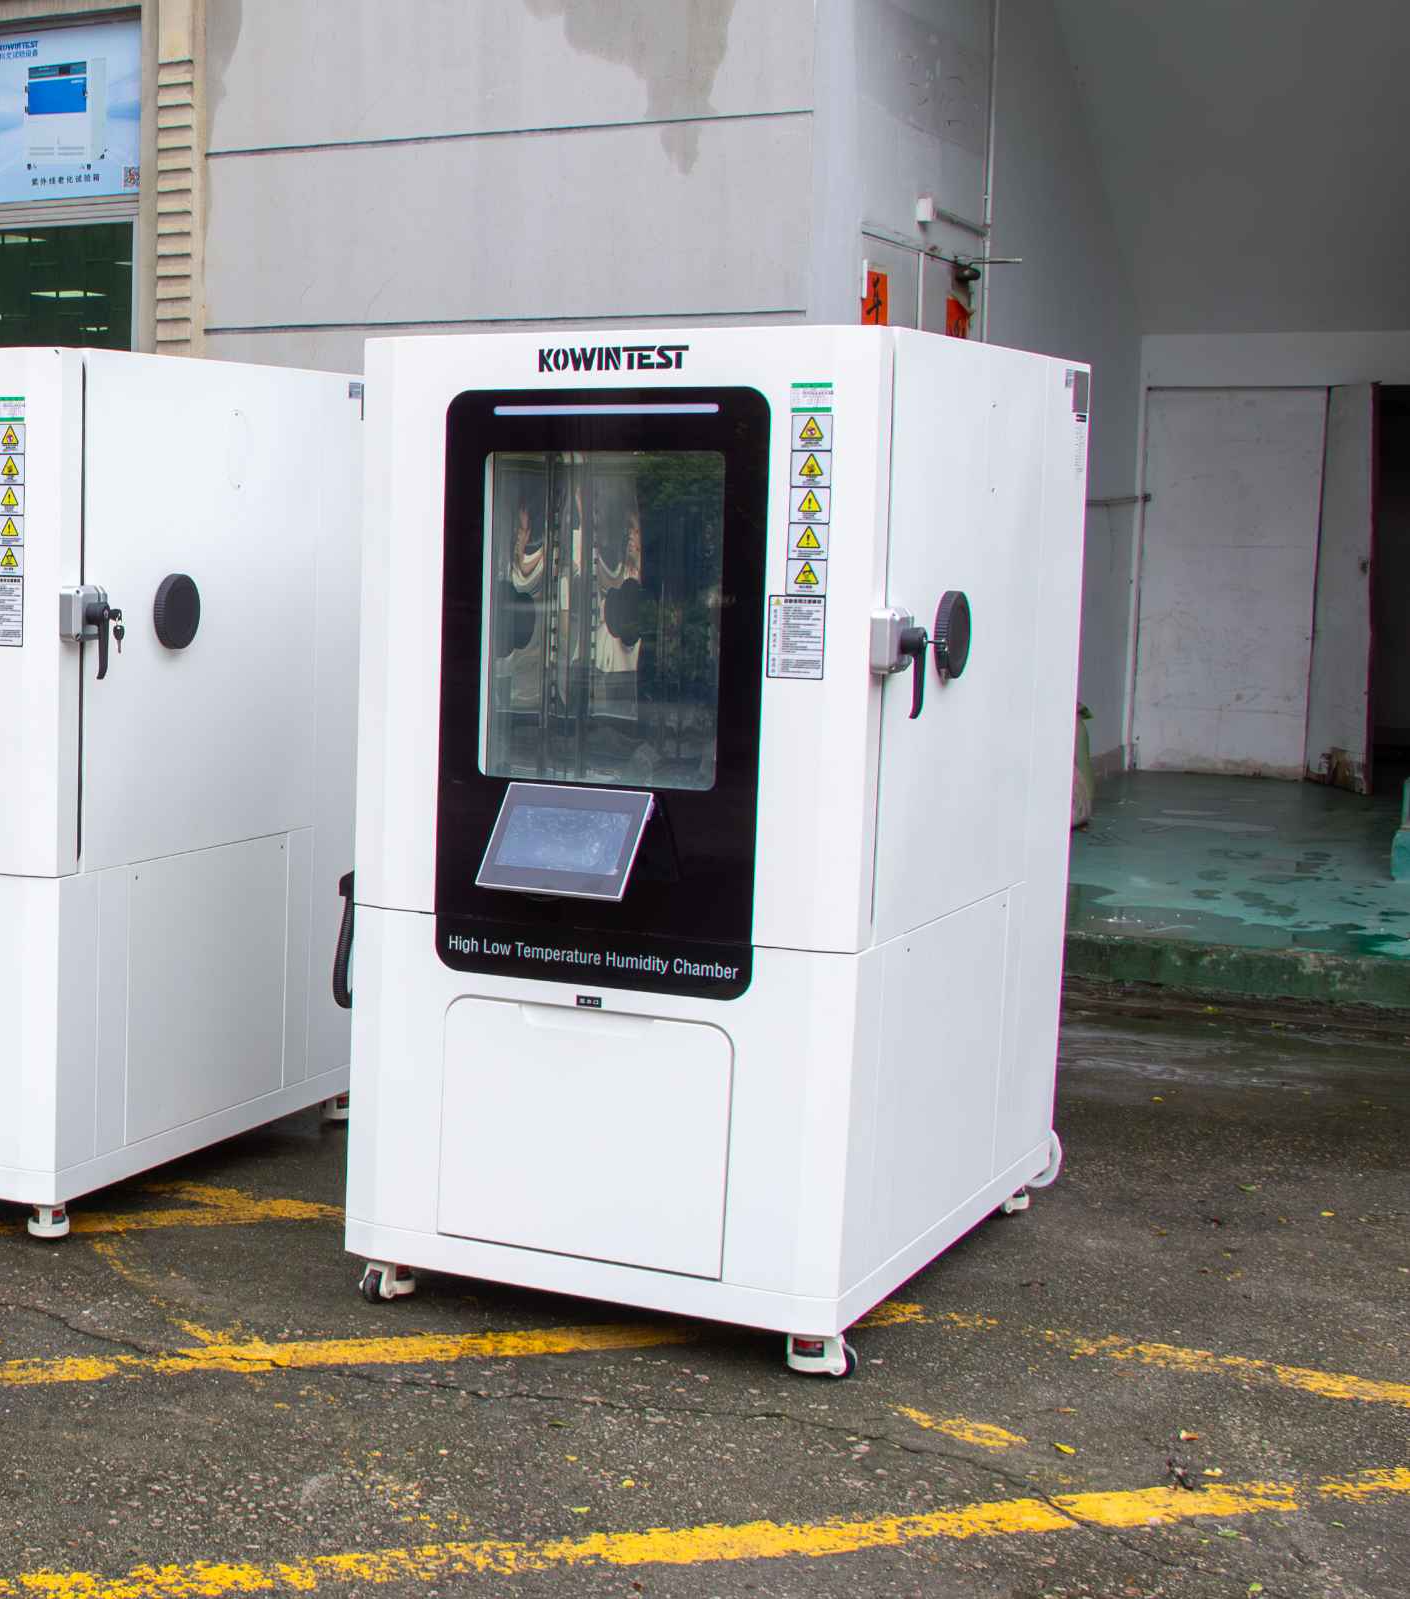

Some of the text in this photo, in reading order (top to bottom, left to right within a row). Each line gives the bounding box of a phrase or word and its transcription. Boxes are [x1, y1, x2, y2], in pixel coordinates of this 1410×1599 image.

[537, 345, 690, 373] KOWINTEST
[448, 935, 739, 980] High Low Temperature Humidity Chamber
